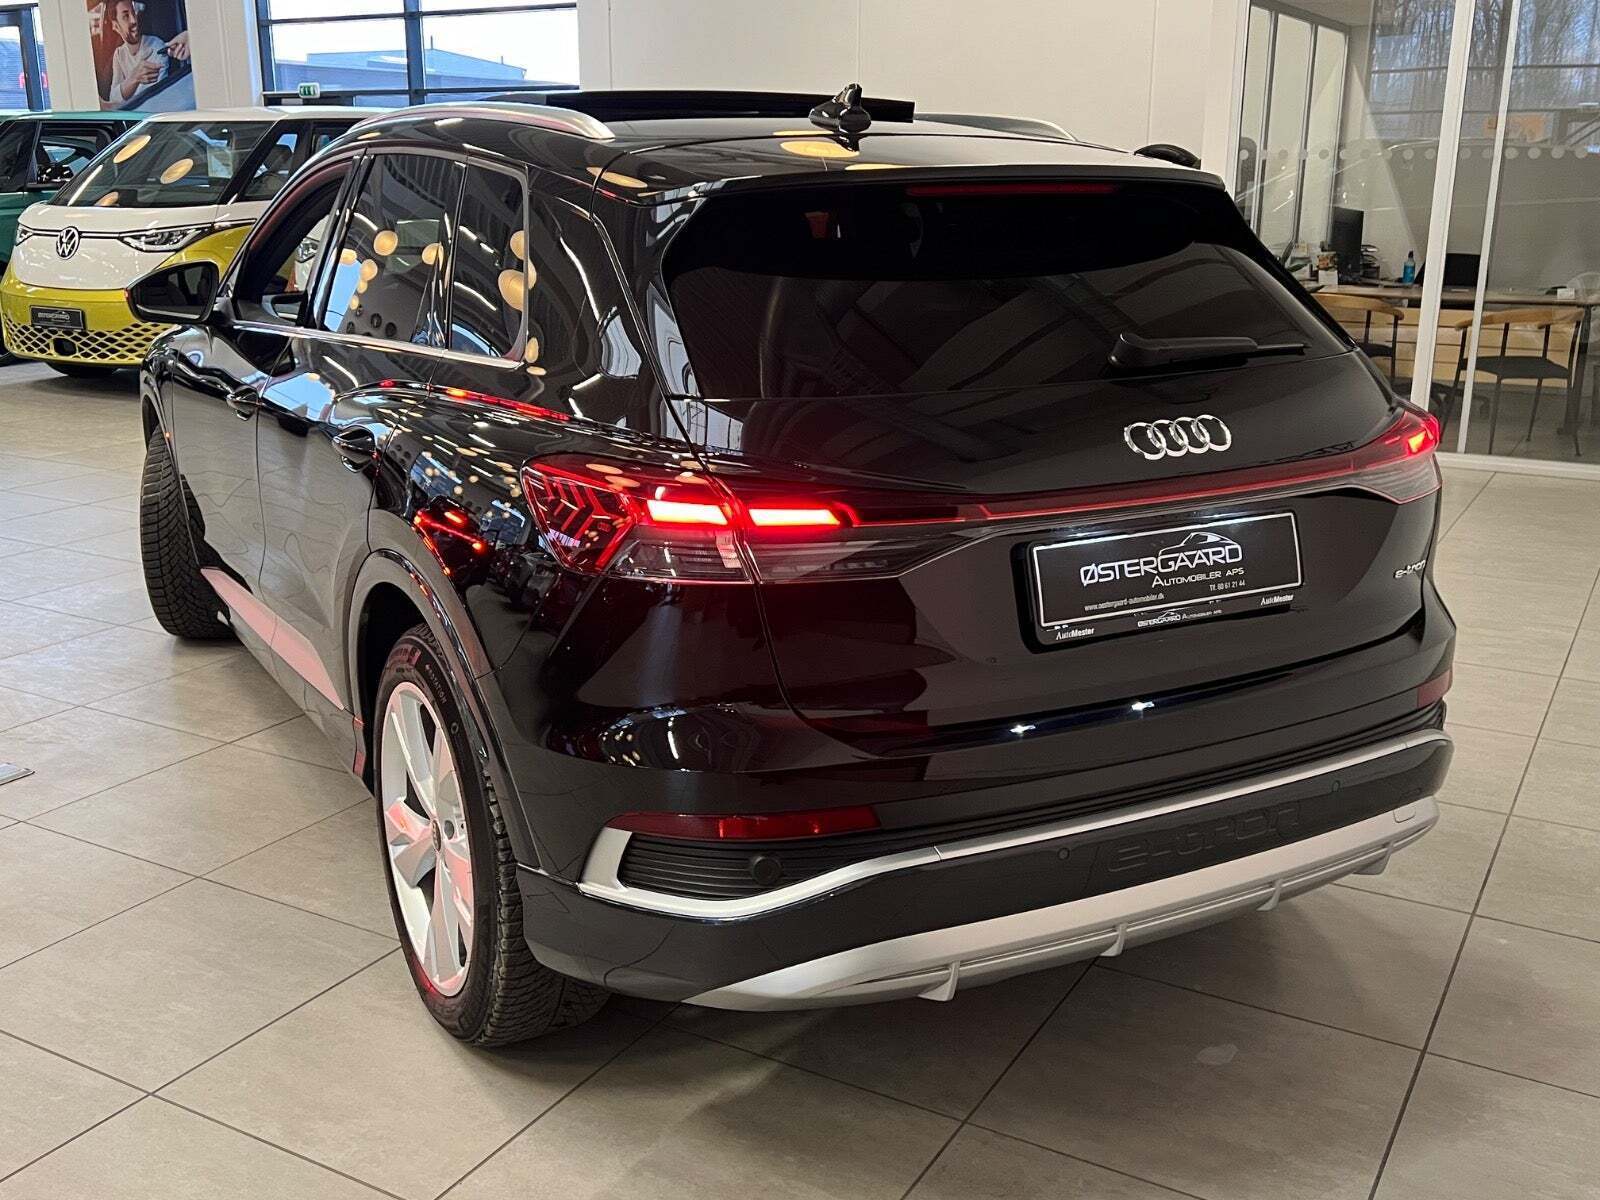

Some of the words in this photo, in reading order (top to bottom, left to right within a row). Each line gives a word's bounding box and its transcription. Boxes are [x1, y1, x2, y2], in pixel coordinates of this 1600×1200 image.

[1080, 544, 1243, 586] ØSTERGAARD
[1225, 567, 1245, 577] APS
[1260, 594, 1294, 606] AutoMester
[1056, 627, 1095, 640] AutoMester
